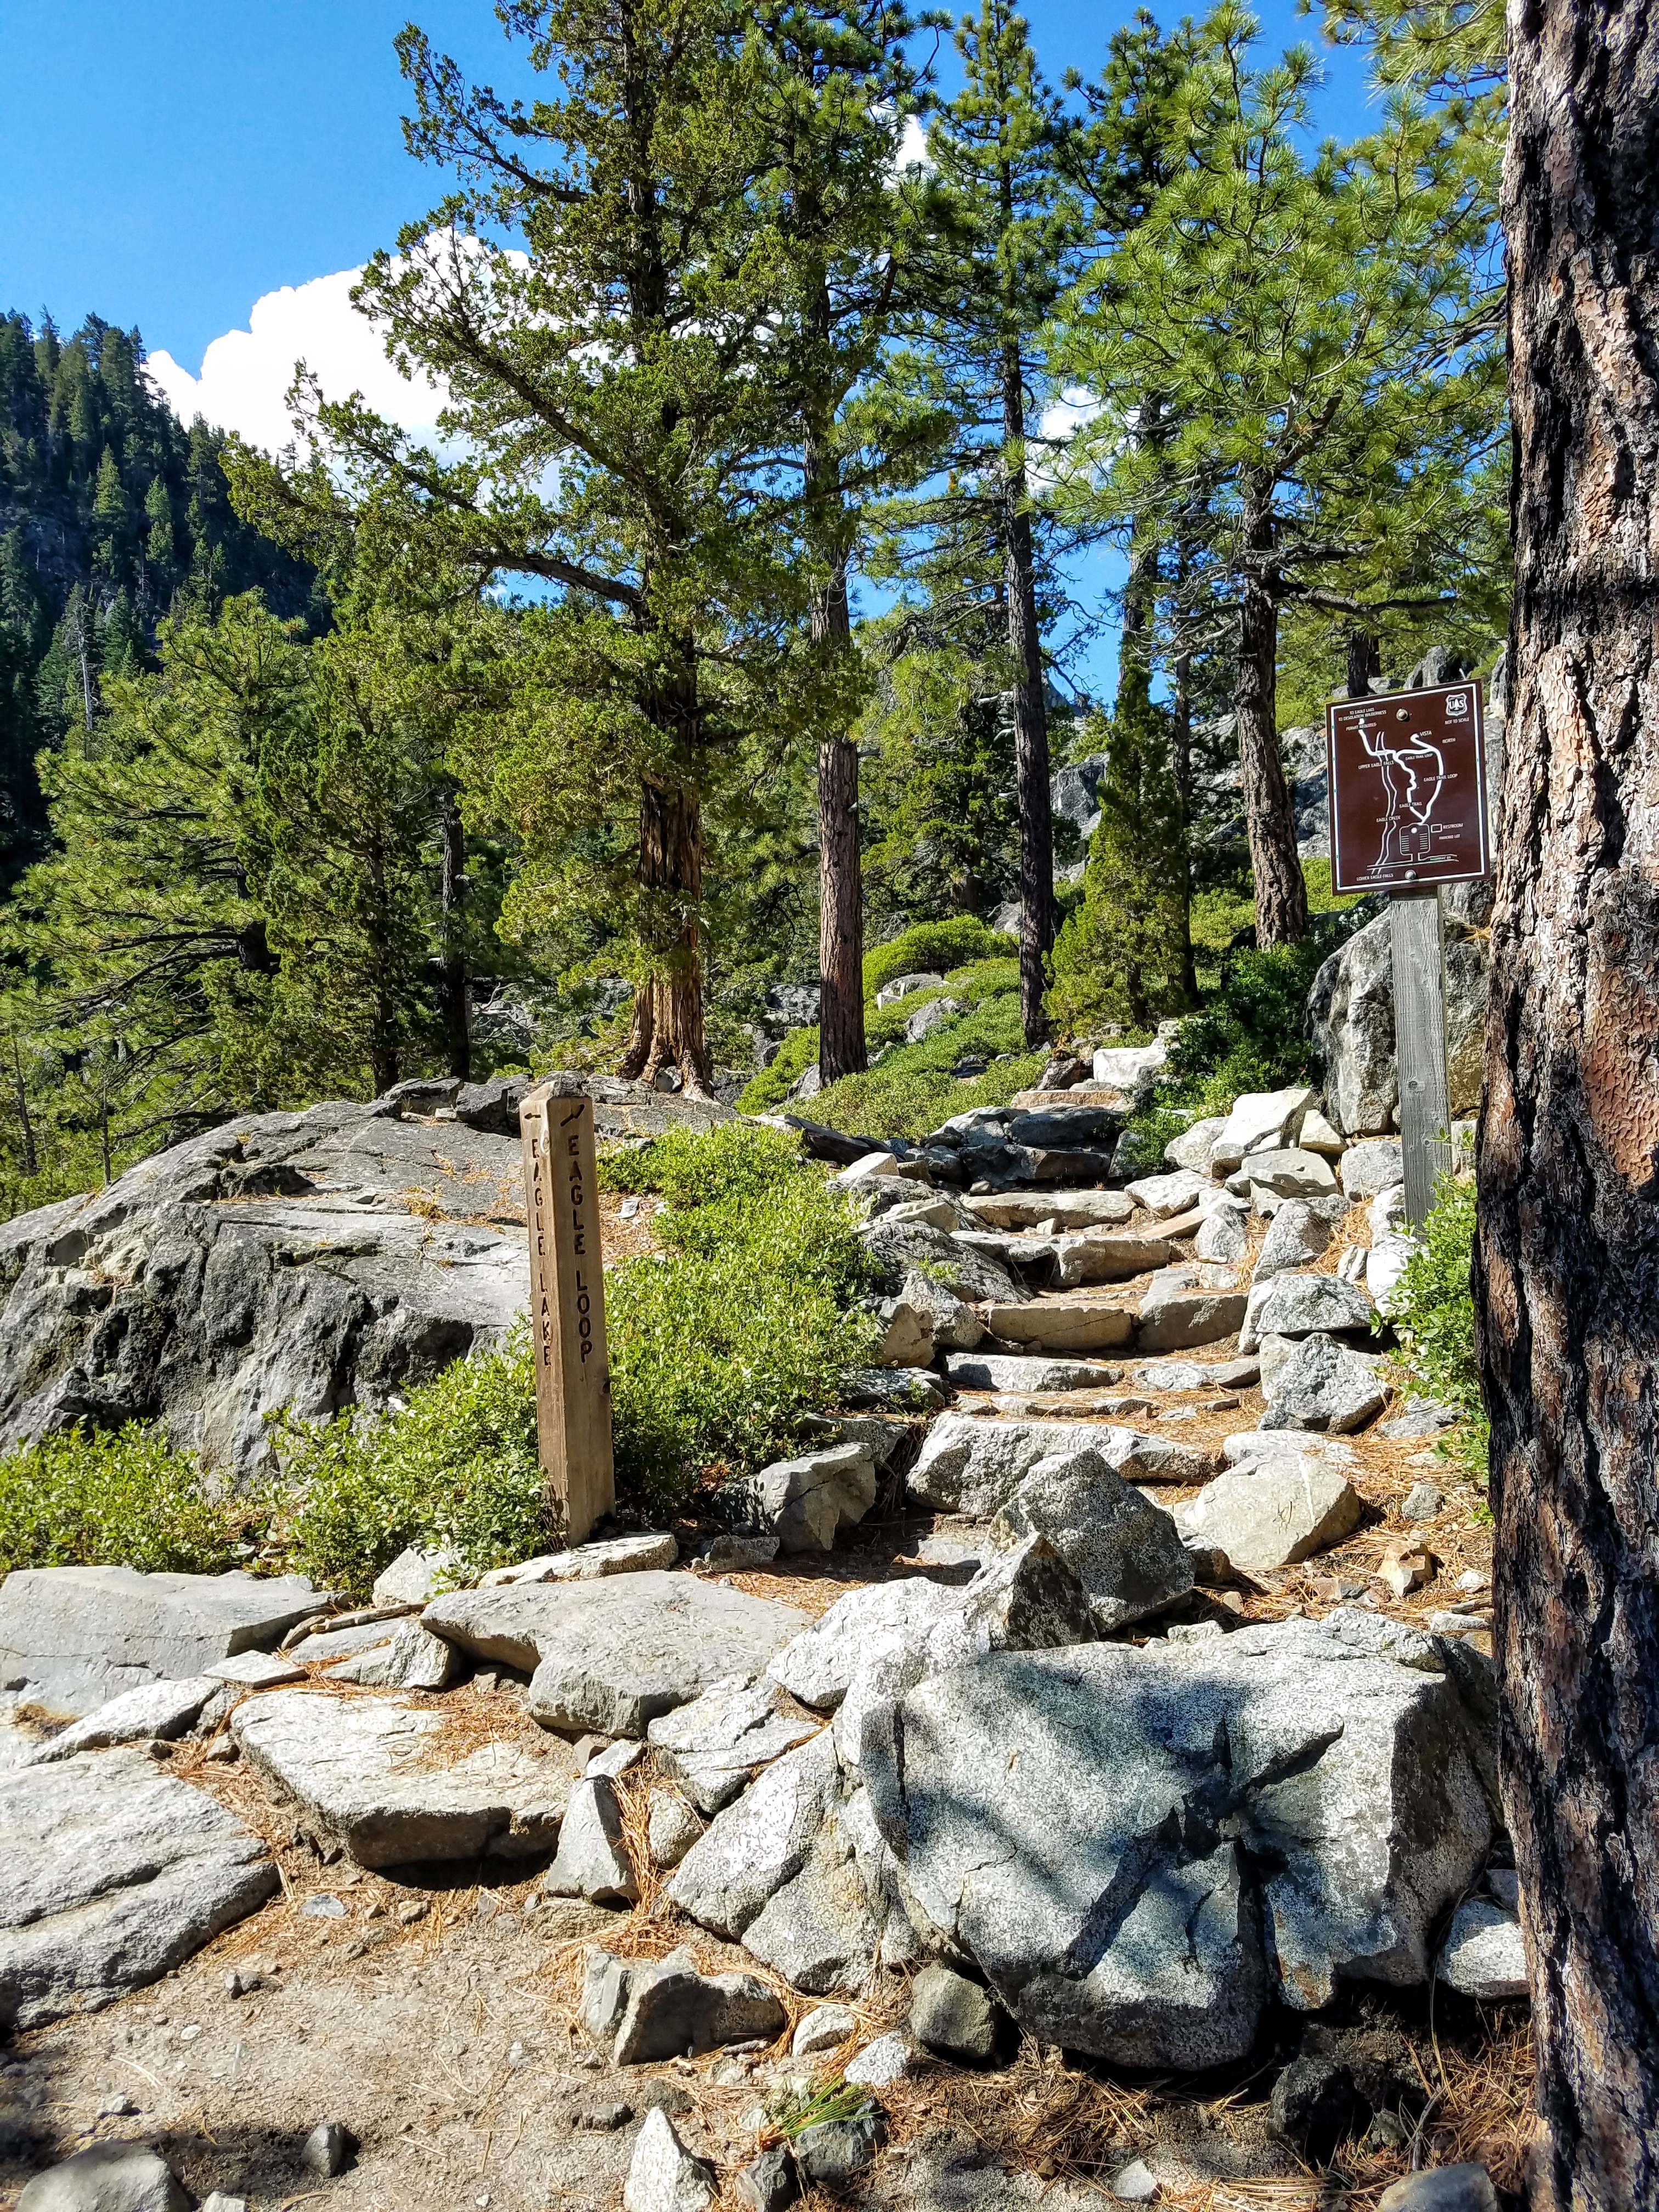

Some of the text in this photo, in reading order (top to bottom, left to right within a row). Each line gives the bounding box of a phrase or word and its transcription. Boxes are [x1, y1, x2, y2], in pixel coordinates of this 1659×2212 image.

[532, 1138, 551, 1366] EAGLE LAKE
[568, 1135, 592, 1364] EAGLE LOOP
